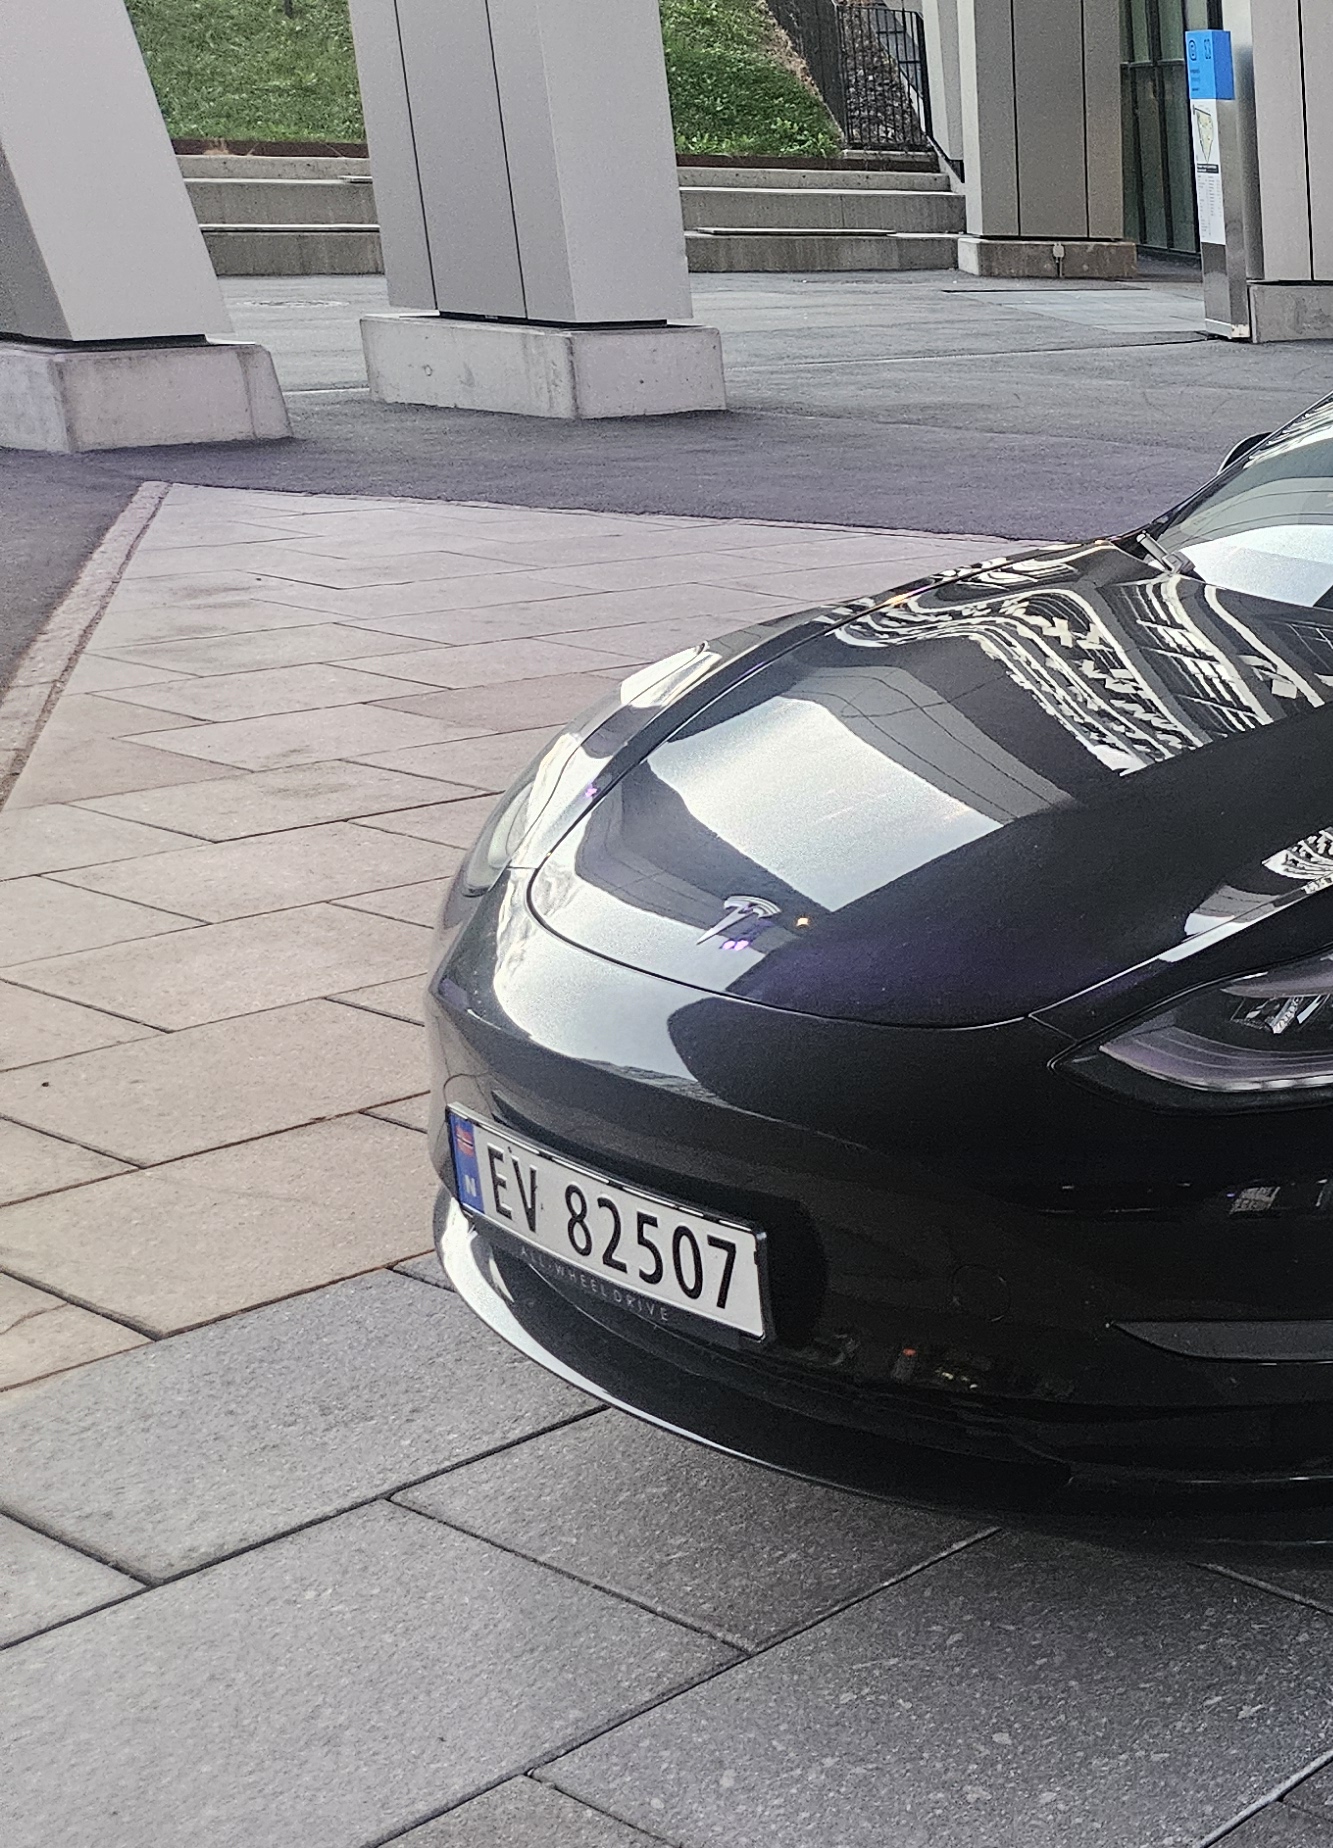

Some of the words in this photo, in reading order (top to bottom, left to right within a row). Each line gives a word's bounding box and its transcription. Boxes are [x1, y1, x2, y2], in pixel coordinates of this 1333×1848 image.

[465, 1174, 477, 1198] N
[487, 1143, 538, 1233] EV
[564, 1184, 737, 1309] 82507
